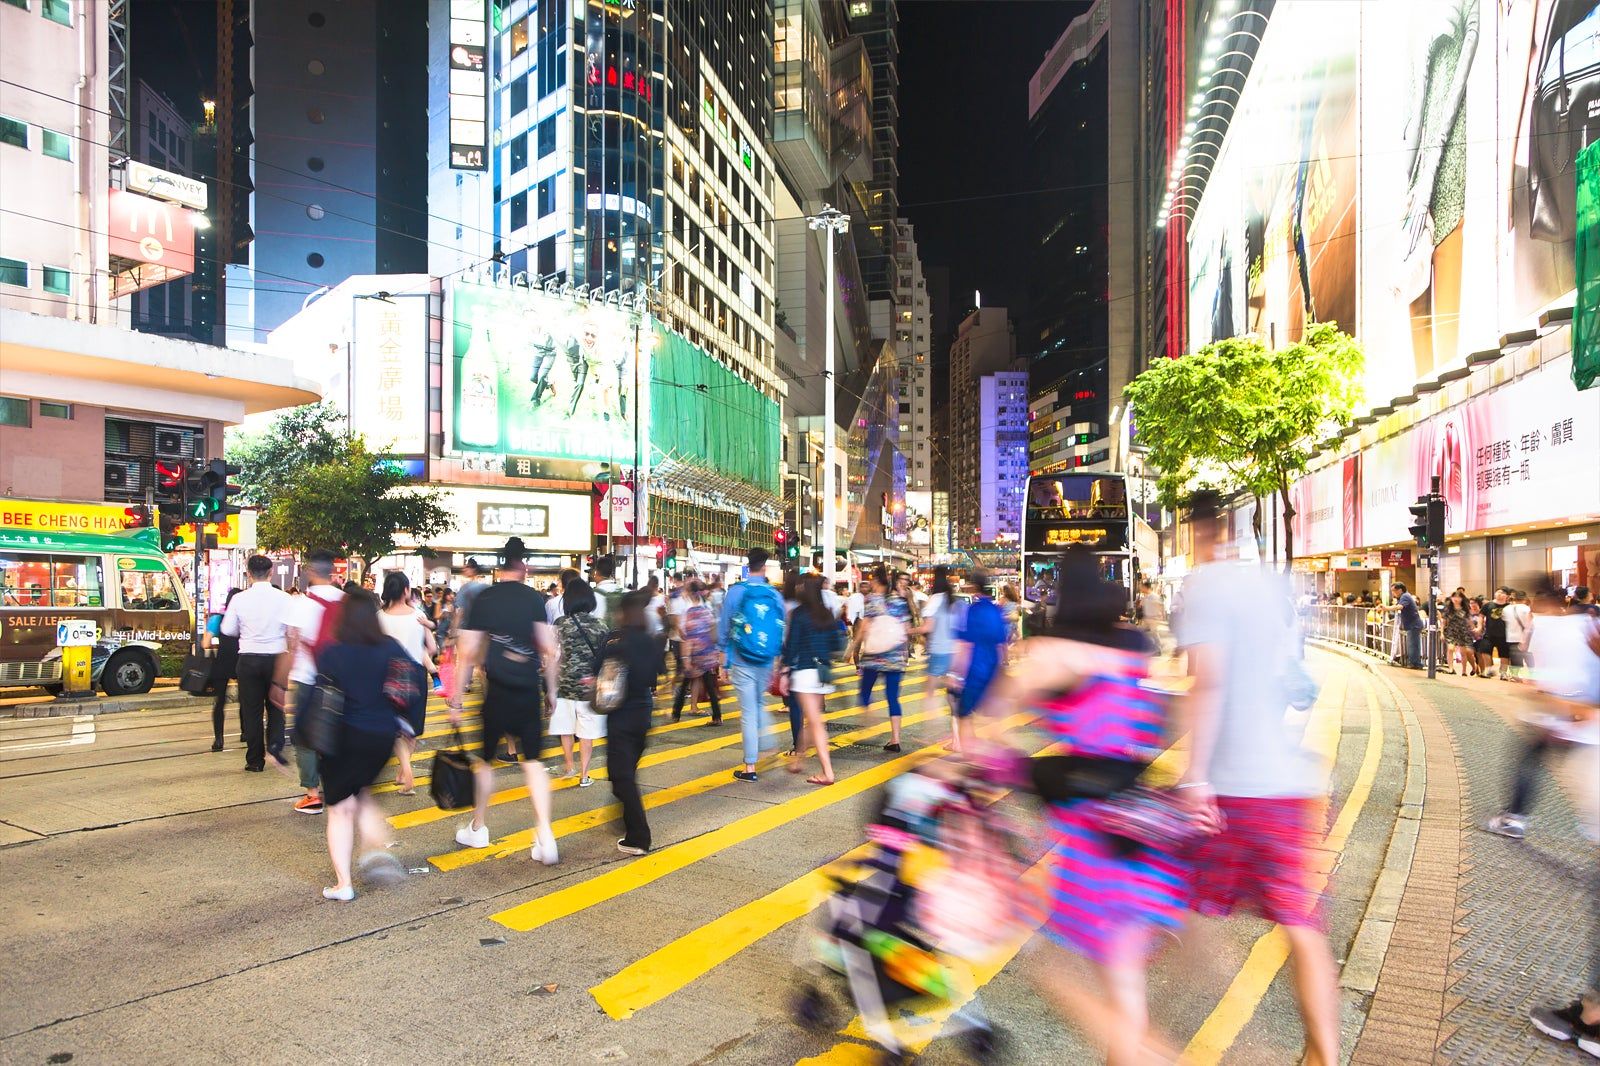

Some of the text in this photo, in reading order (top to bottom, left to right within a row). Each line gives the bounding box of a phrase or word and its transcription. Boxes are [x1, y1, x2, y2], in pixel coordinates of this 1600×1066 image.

[607, 496, 630, 506] asa
[3, 512, 33, 526] BEE
[38, 514, 89, 528] CHENG
[8, 616, 37, 626] SALE
[138, 630, 191, 641] Mid-Levels
